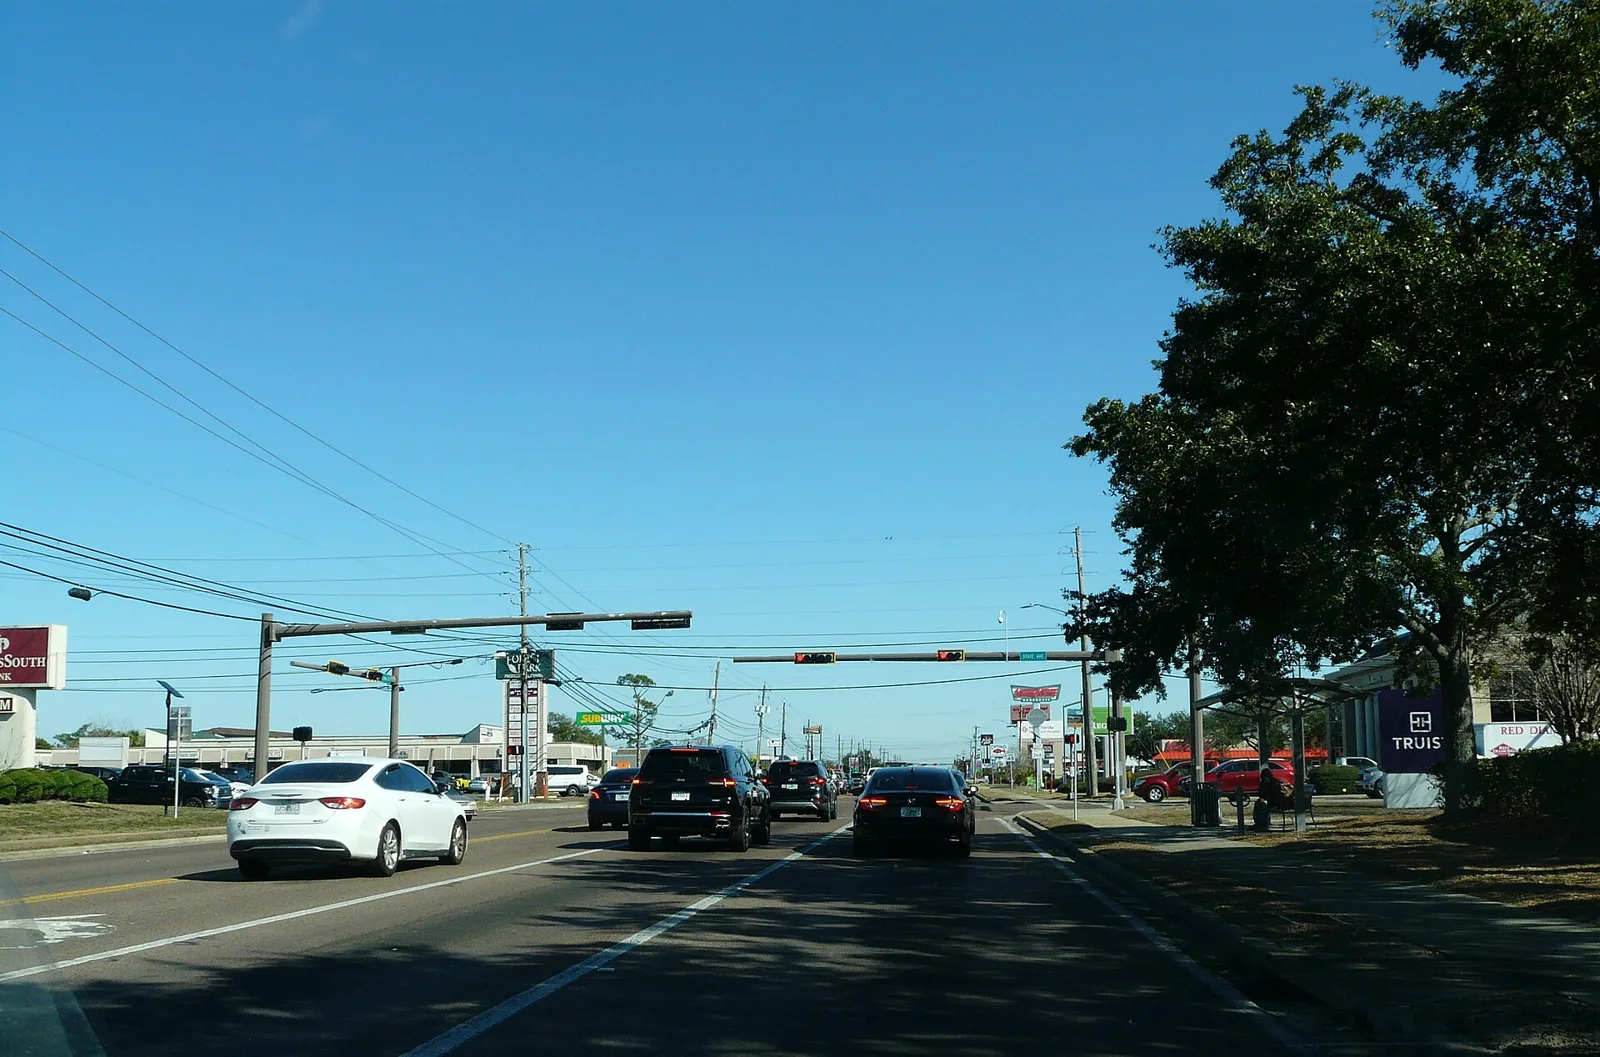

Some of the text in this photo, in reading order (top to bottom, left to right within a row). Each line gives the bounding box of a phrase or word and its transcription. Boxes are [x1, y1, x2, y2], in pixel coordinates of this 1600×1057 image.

[580, 713, 626, 723] SUBWAY
[1501, 726, 1524, 735] RED
[1392, 737, 1444, 750] TRUIS
